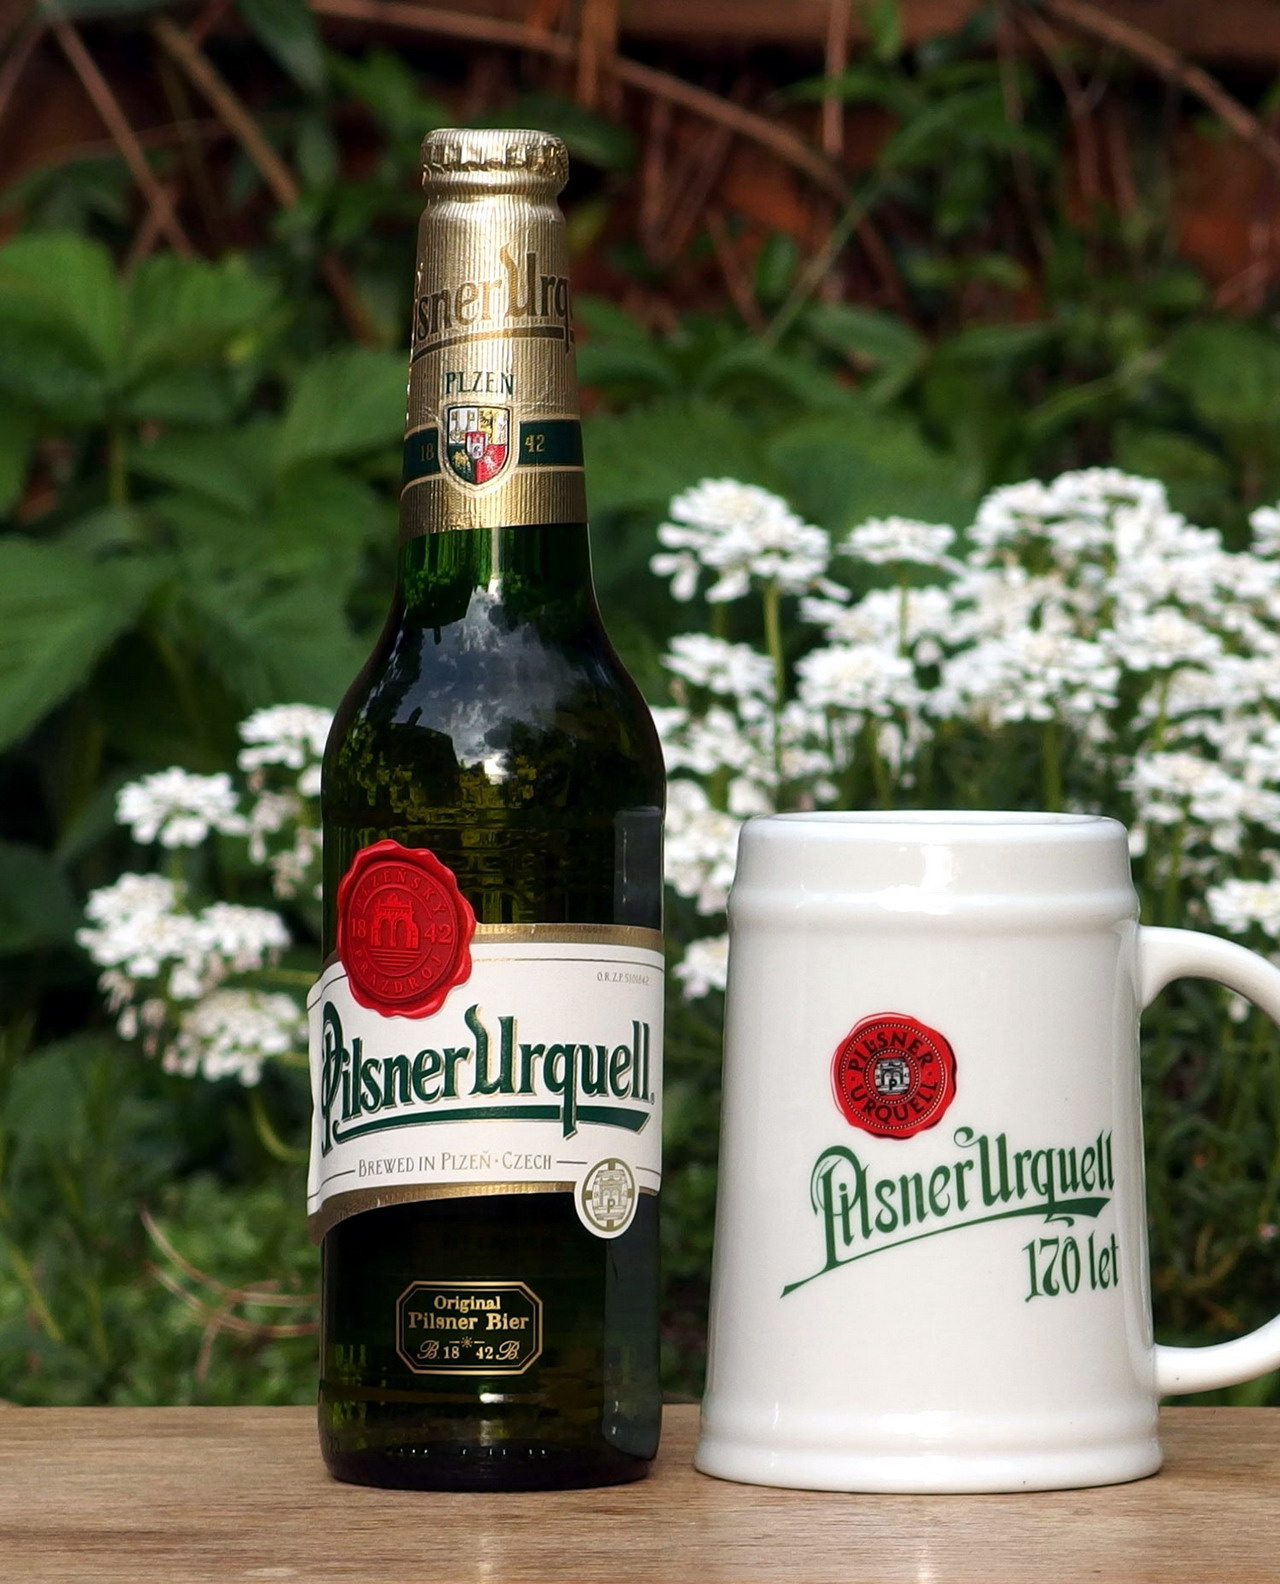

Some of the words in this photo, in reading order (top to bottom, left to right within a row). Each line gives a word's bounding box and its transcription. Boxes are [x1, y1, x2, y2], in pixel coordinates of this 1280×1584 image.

[420, 443, 435, 462] 18
[524, 434, 545, 453] 42
[351, 918, 366, 938] 18
[424, 922, 454, 944] 42
[321, 1001, 474, 1158] Pilsner
[463, 1003, 651, 1141] Urquell
[888, 1078, 898, 1091] P
[850, 1081, 938, 1124] URQUELL
[418, 1156, 436, 1172] IN
[606, 1198, 616, 1214] P
[810, 1145, 974, 1271] Pilsner
[953, 1126, 1115, 1228] Urquell
[1021, 1236, 1081, 1303] 170
[1088, 1229, 1119, 1291] let
[433, 1295, 501, 1313] Original
[408, 1311, 478, 1330] Pilsner
[485, 1312, 530, 1331] Bier
[443, 1346, 460, 1360] 18
[476, 1346, 494, 1360] 42
